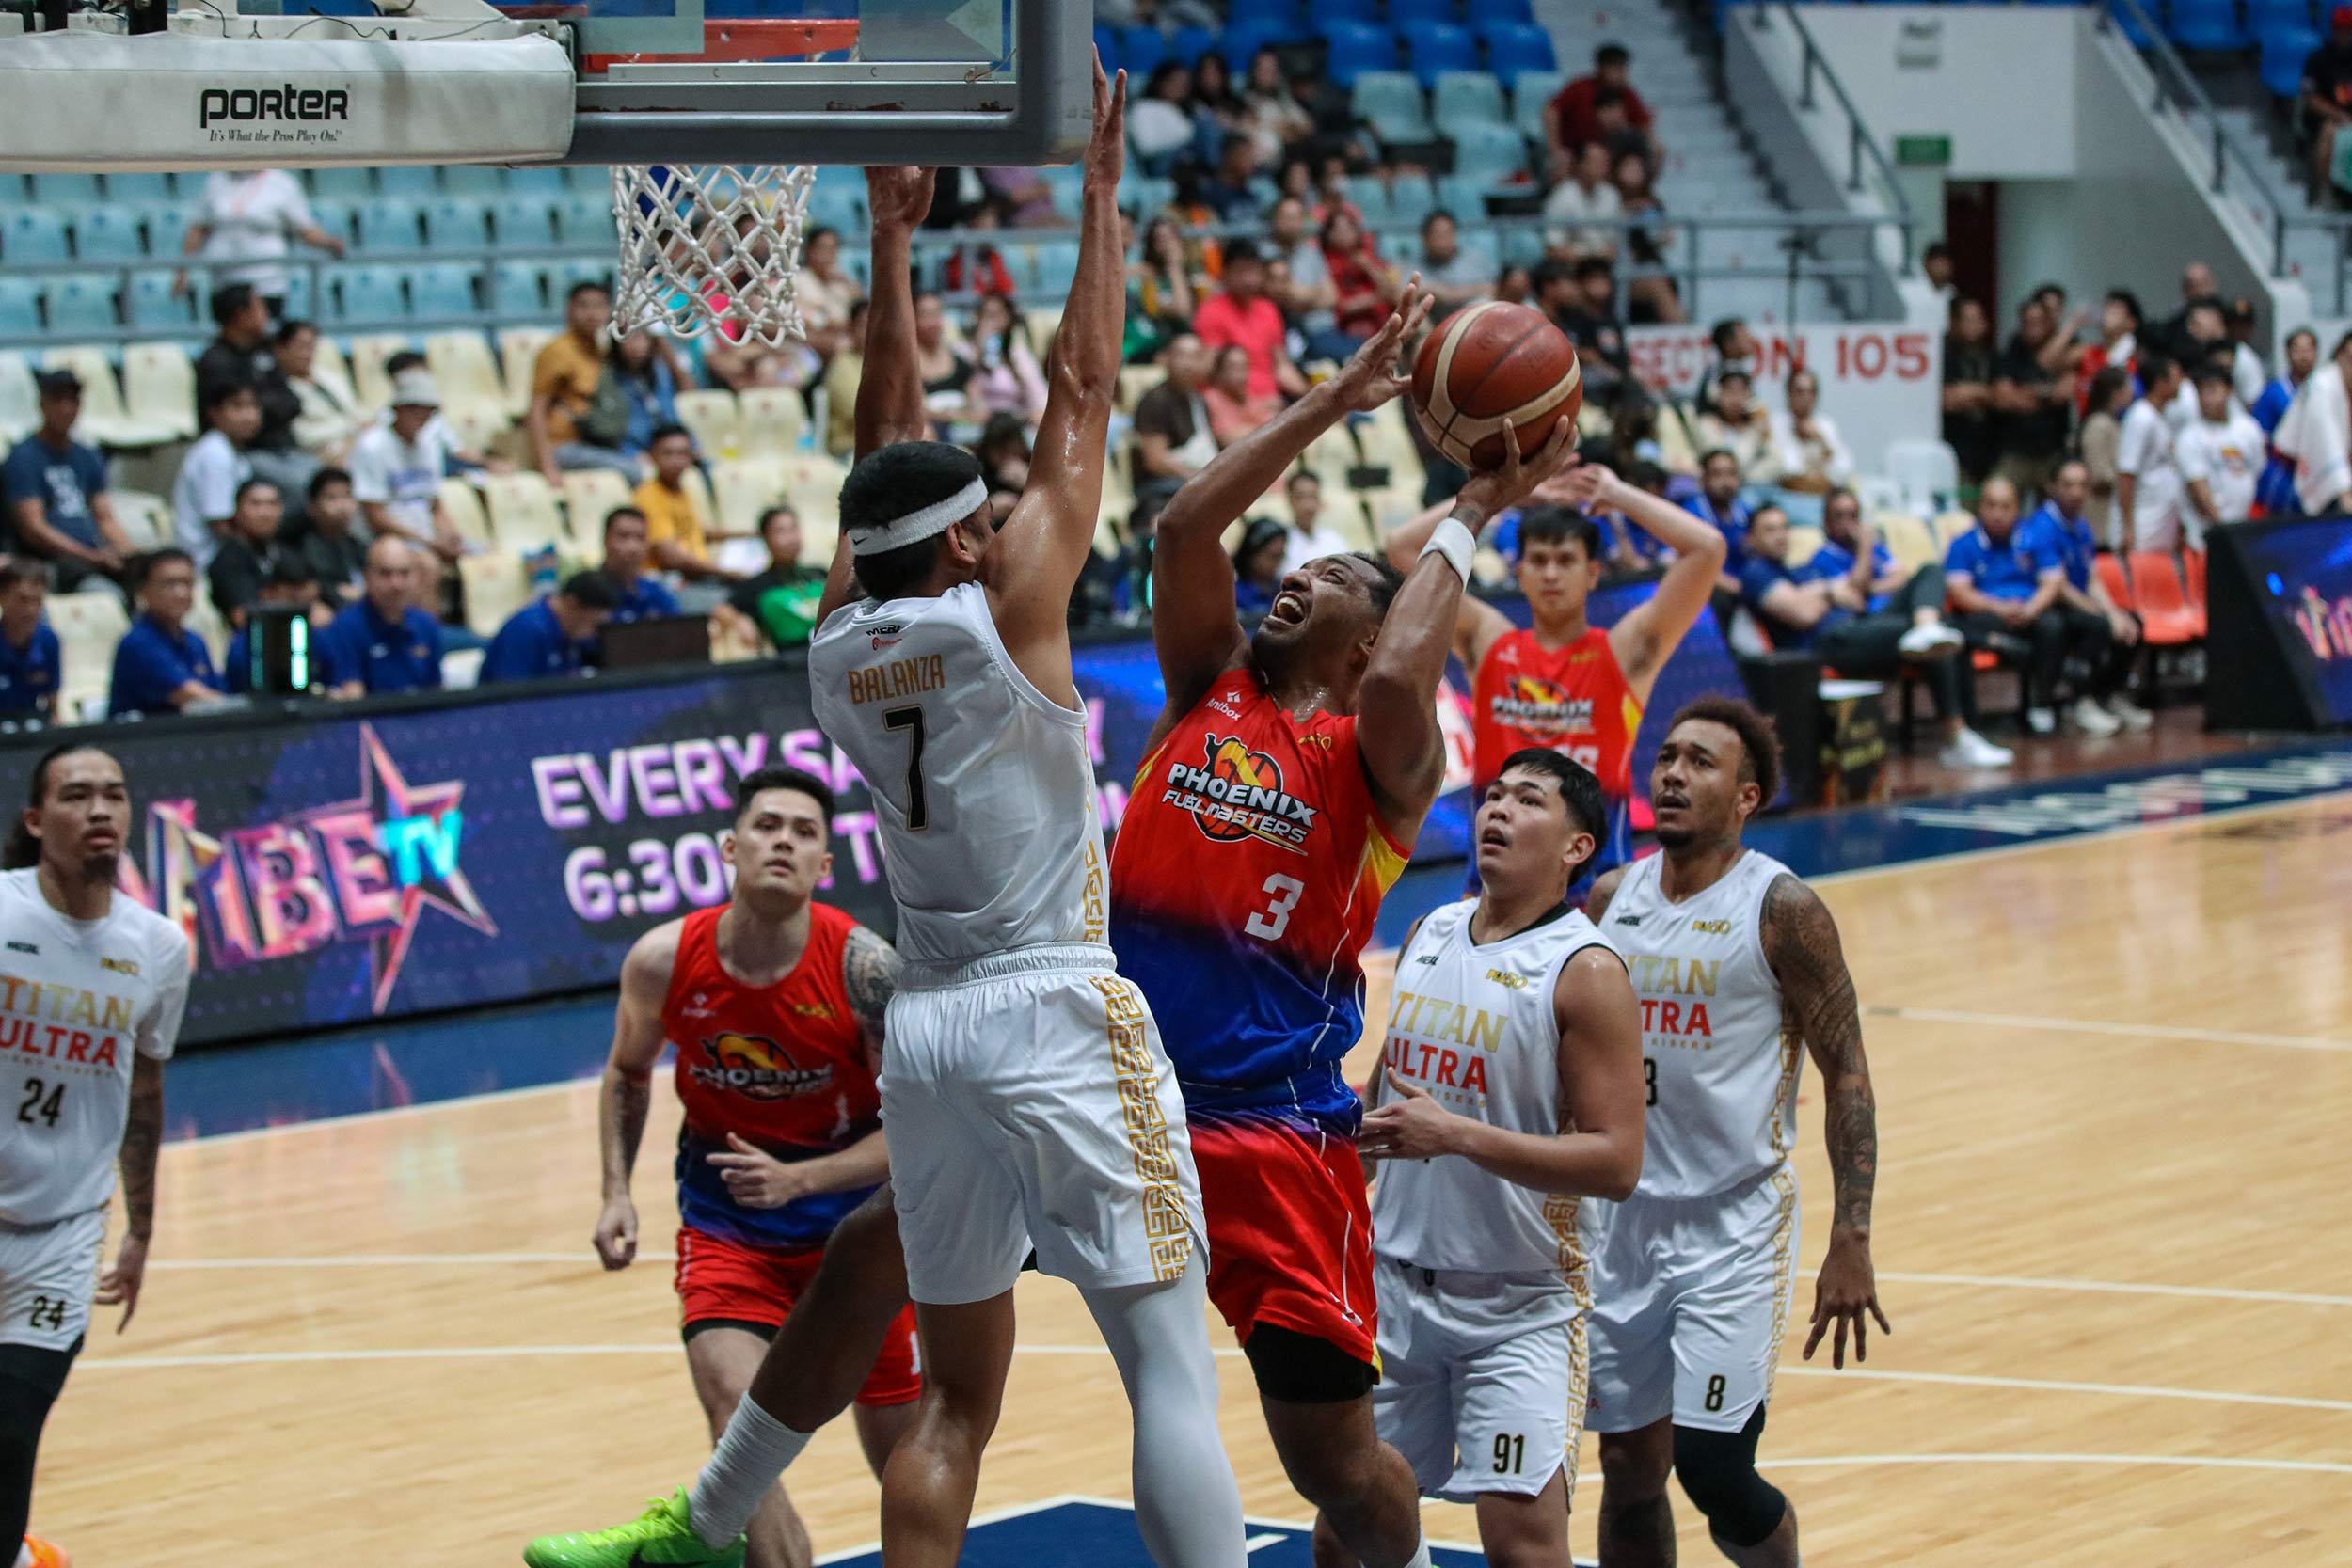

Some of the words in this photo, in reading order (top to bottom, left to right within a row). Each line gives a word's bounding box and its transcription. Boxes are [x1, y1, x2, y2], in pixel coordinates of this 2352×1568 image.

[210, 129, 225, 142] It's
[228, 129, 252, 142] What
[255, 129, 270, 142] the
[273, 129, 294, 142] Pros
[296, 129, 317, 145] Play
[848, 654, 946, 705] BALANZA
[532, 730, 769, 829] EVERY
[882, 703, 929, 832] 7
[1166, 762, 1319, 830] PHOENIX
[1244, 872, 1305, 941] 3
[1624, 955, 1722, 997] ITAN
[0, 974, 135, 1032] TITAN
[1389, 990, 1509, 1053] TITAN
[1641, 999, 1712, 1037] TRA
[0, 1015, 117, 1068] ULTRA
[1384, 1035, 1487, 1094] ULTRA
[17, 1076, 67, 1128] 24
[30, 1295, 65, 1331] 24
[1704, 1374, 1726, 1412] 8
[1492, 1433, 1525, 1475] 91
